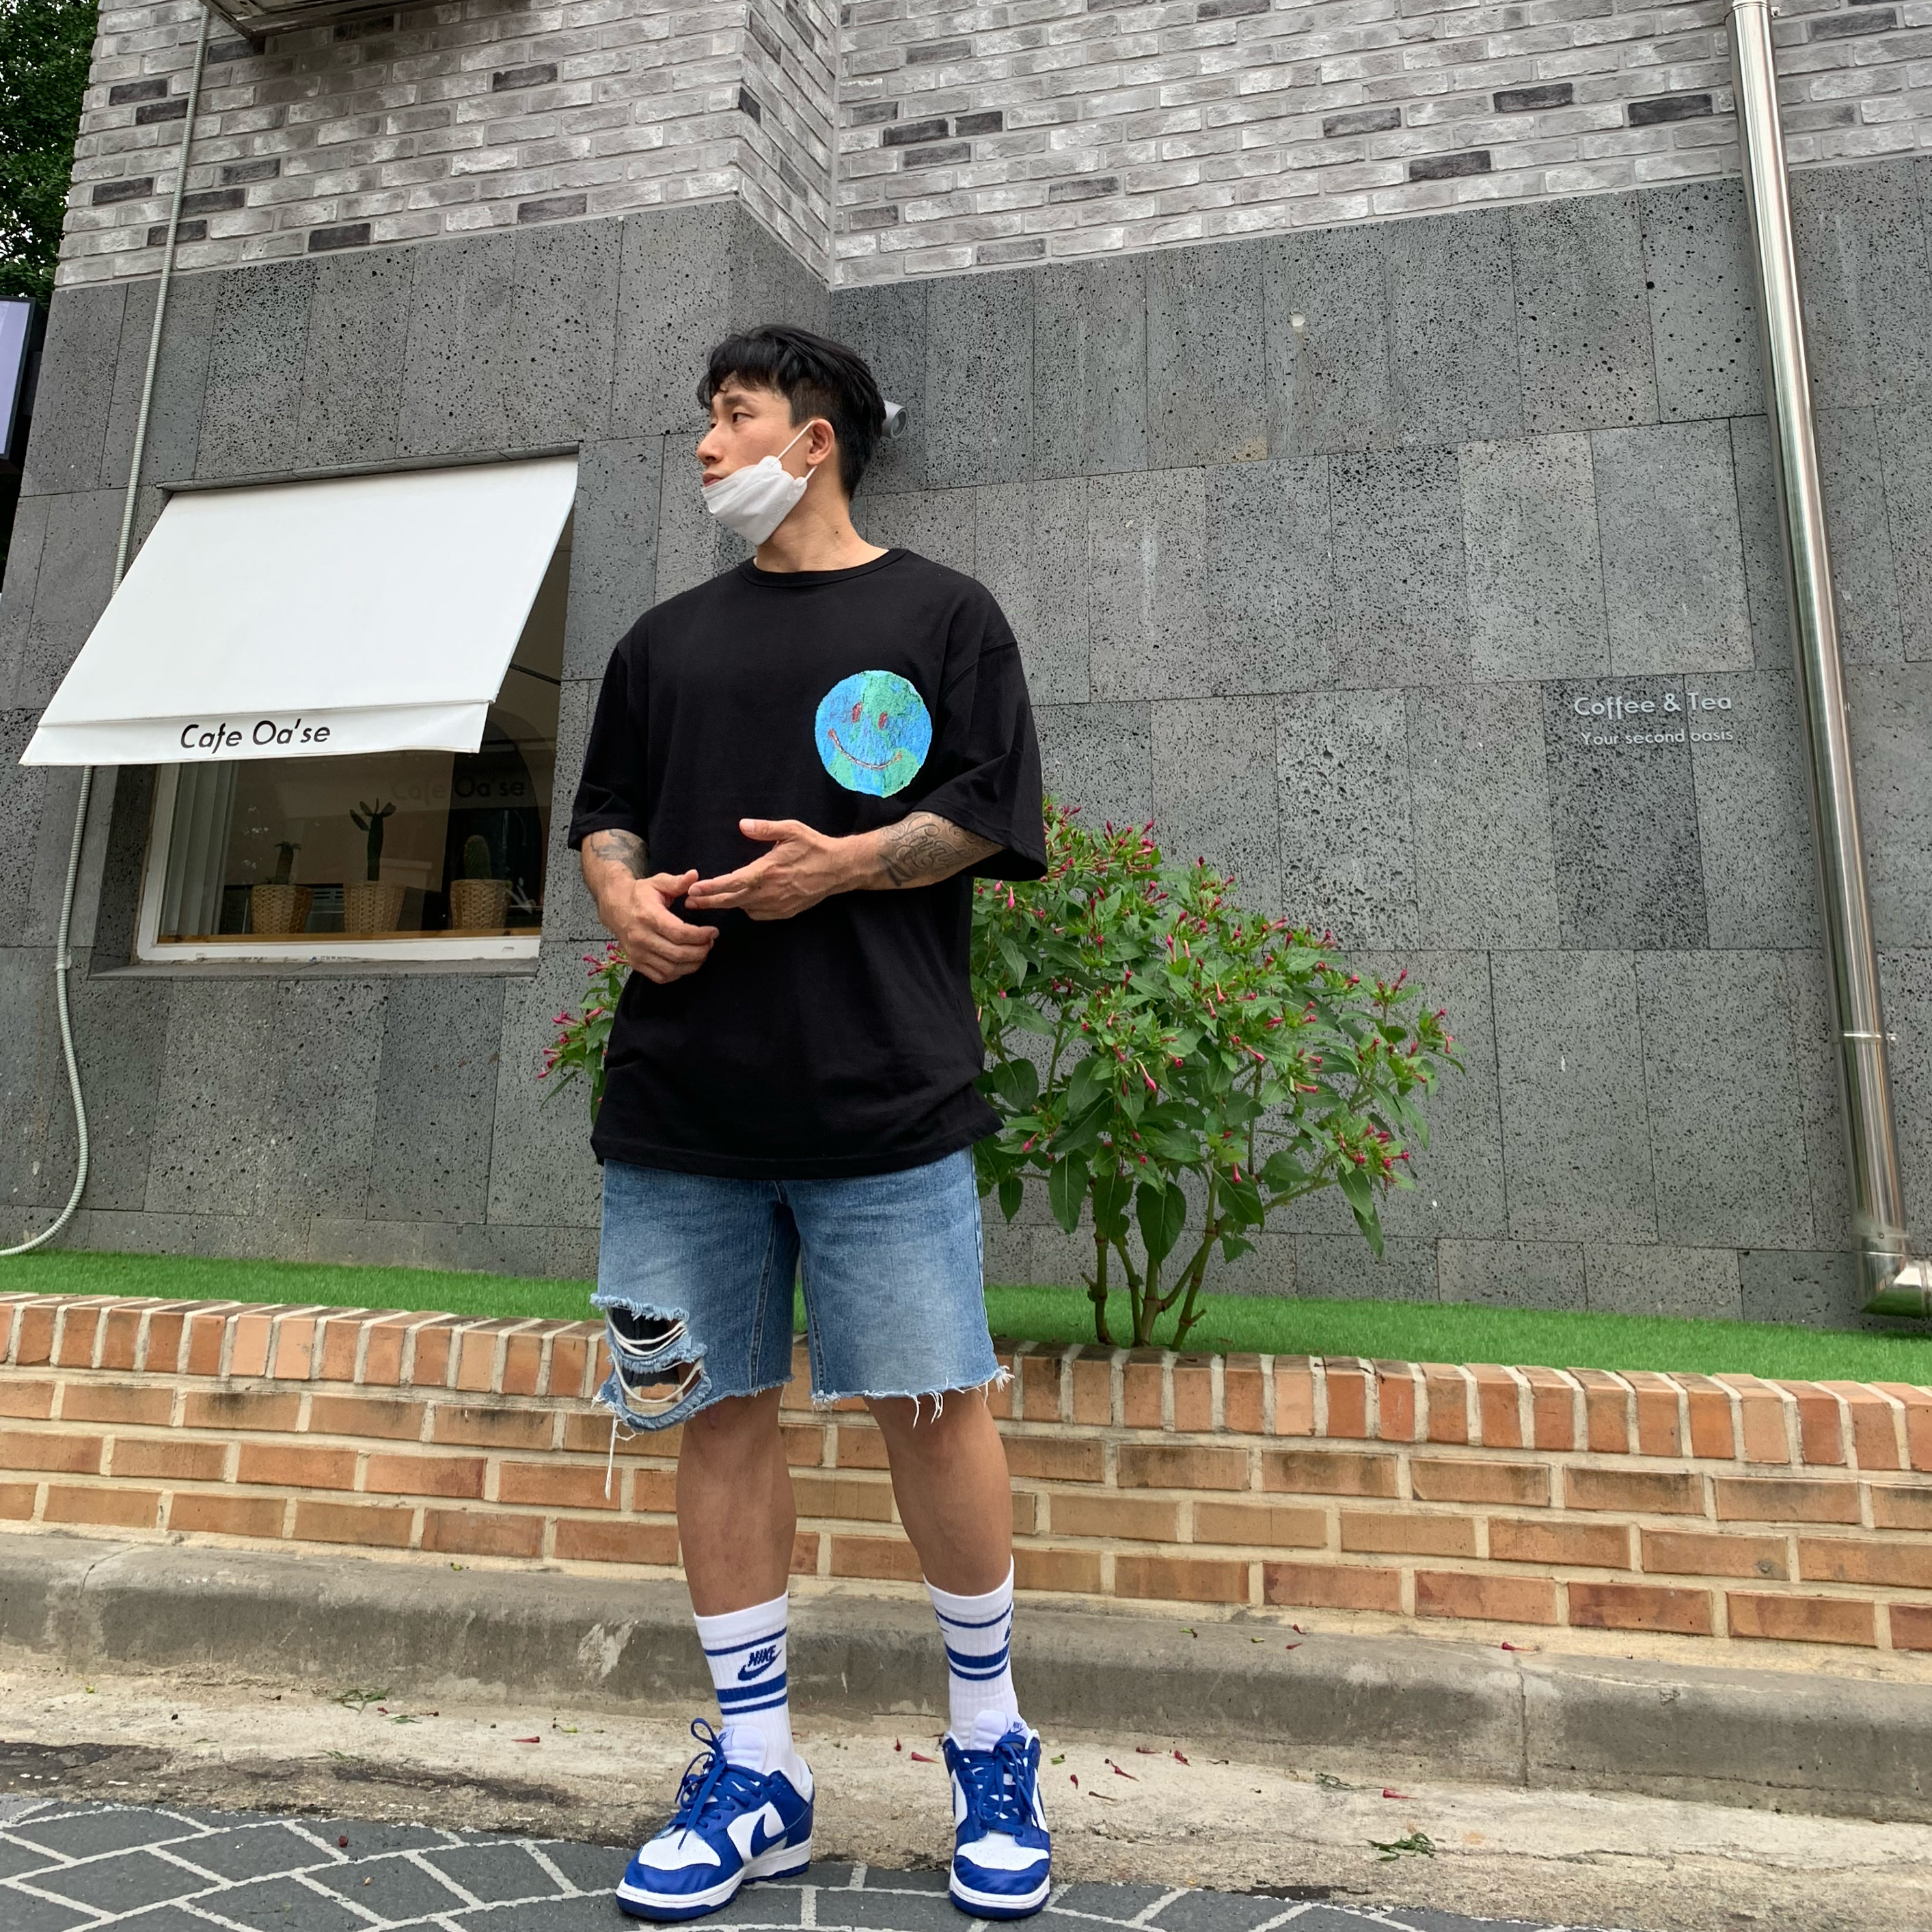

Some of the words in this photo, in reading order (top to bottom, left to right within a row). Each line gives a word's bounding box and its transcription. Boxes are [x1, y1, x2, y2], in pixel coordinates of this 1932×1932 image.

[1574, 696, 1656, 720] Coffee
[1663, 693, 1682, 713] &
[1687, 692, 1732, 711] Tea
[180, 722, 243, 754] Cafe
[252, 718, 331, 746] Oa'se
[1580, 731, 1619, 746] Your
[1625, 728, 1685, 745] second
[1690, 726, 1734, 742] oasis
[392, 778, 446, 806] Cafe
[748, 1644, 776, 1668] NIKE
